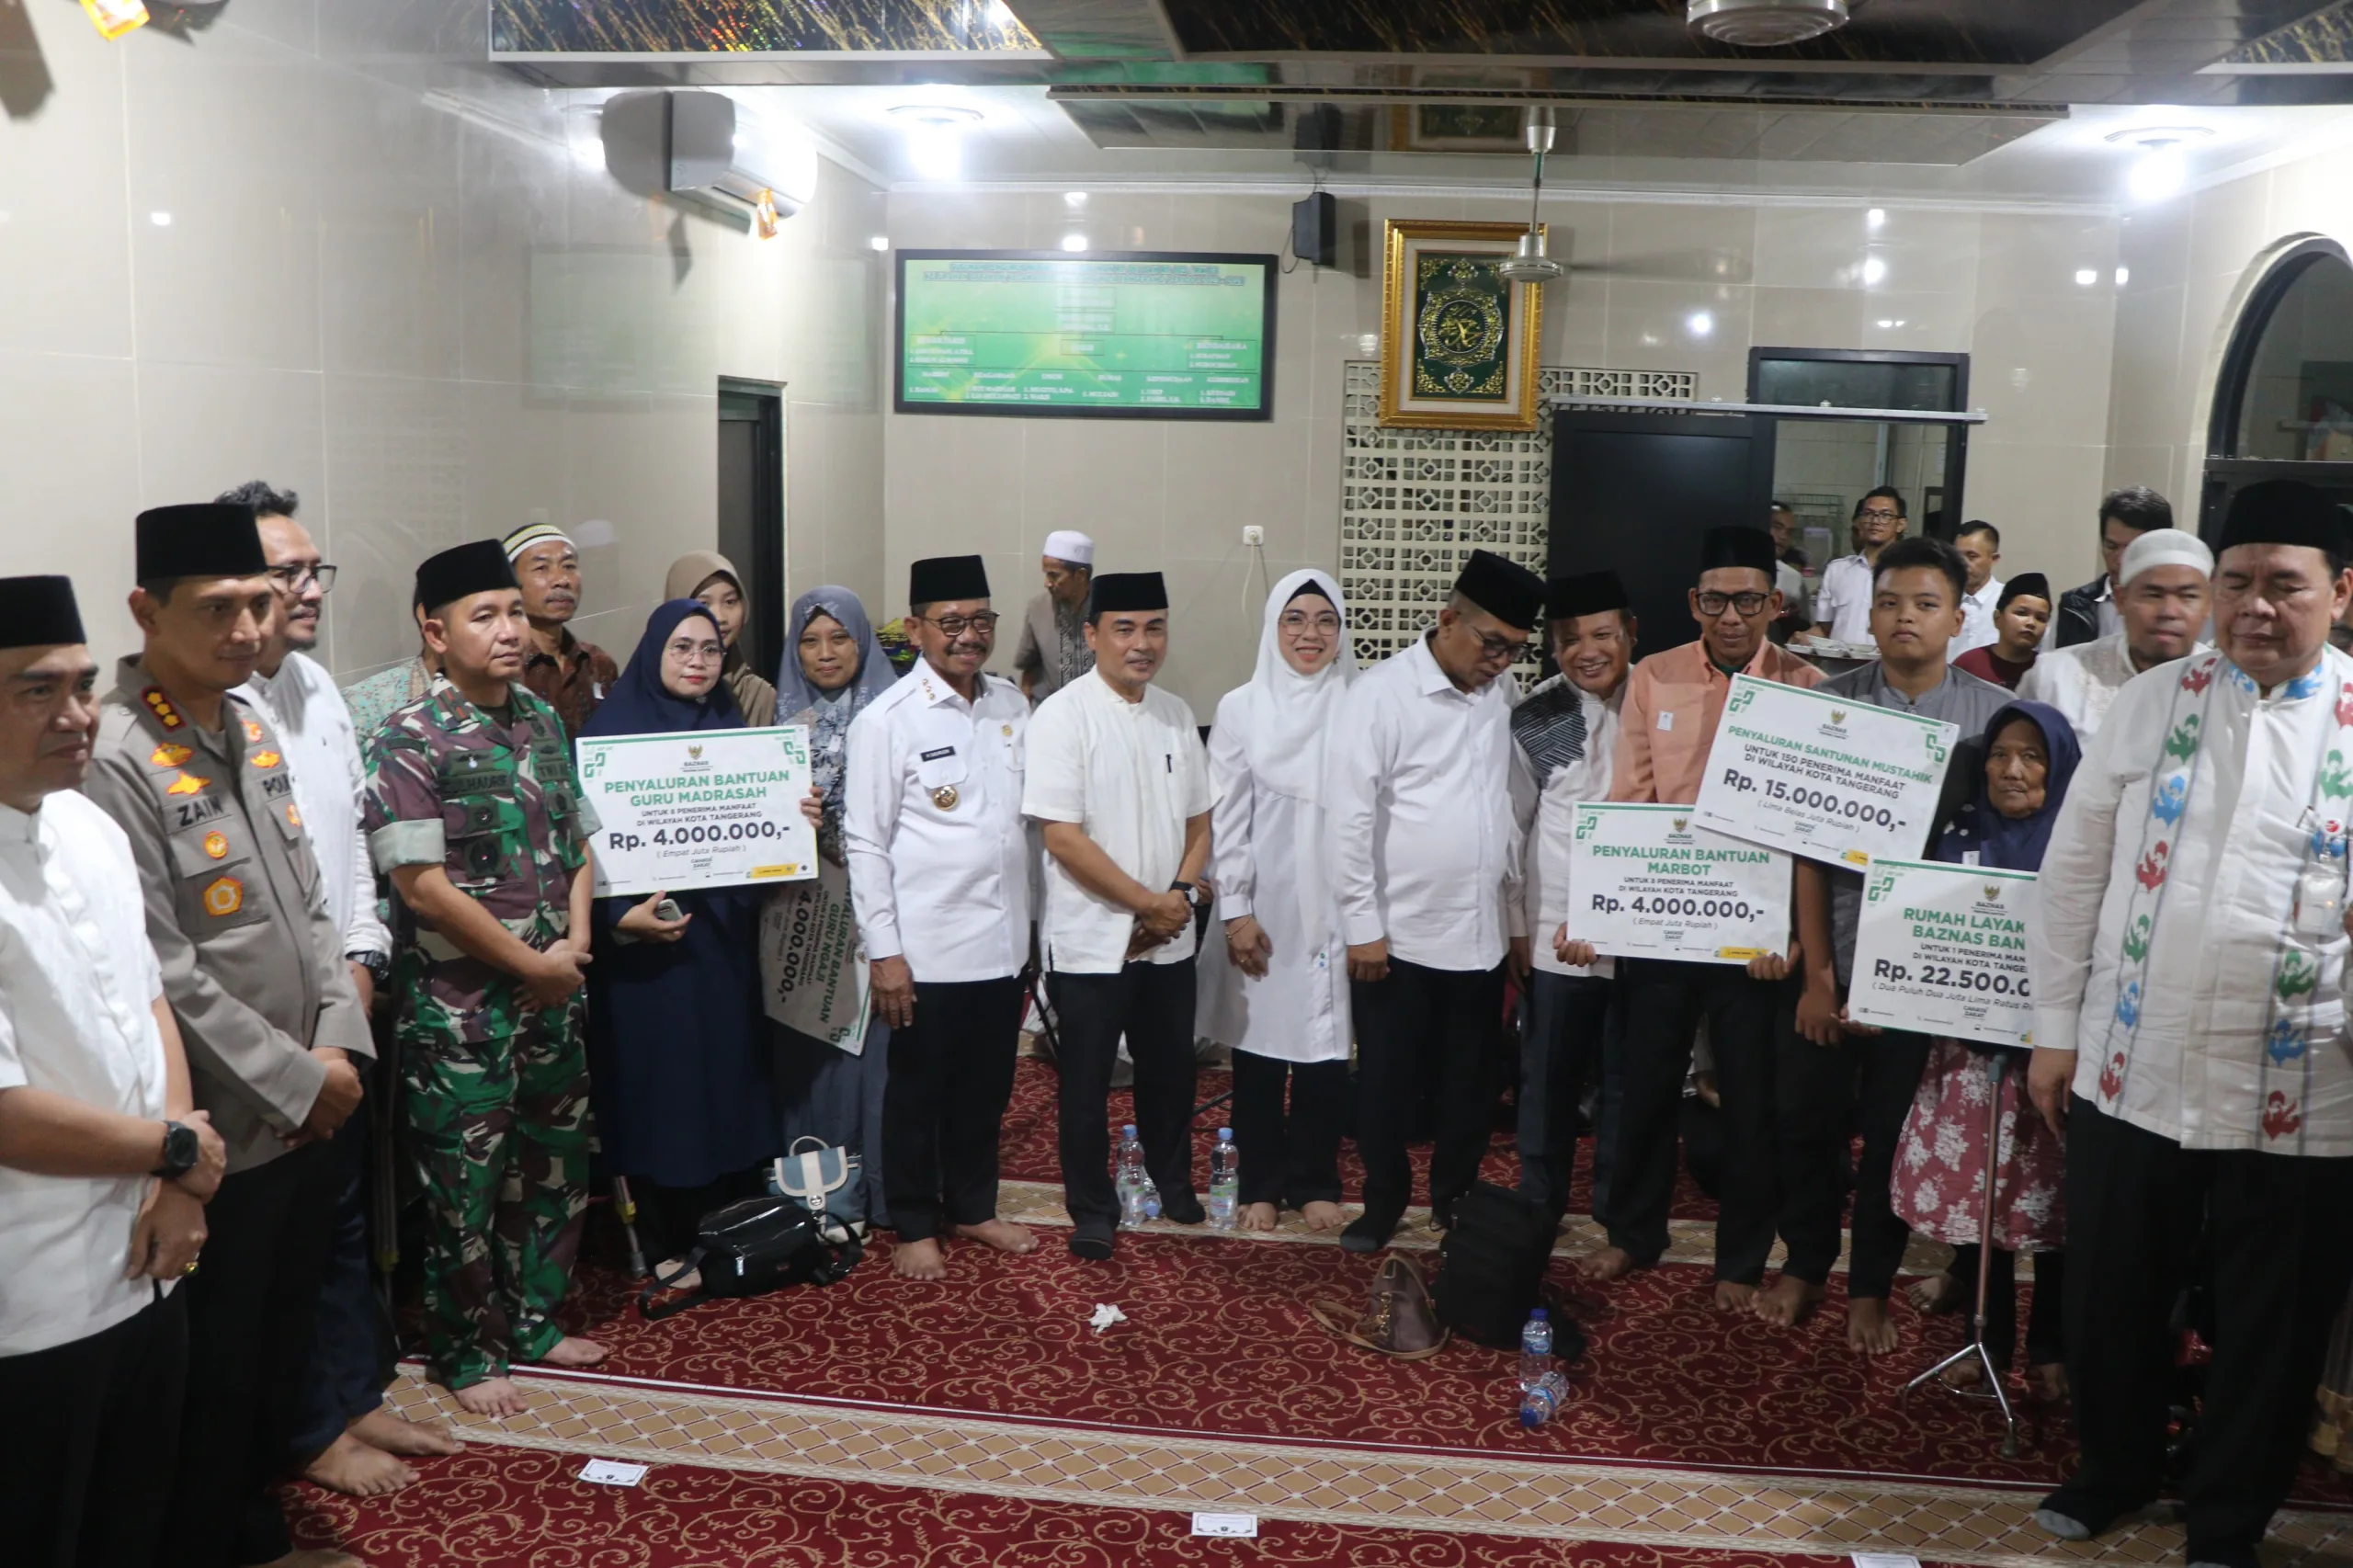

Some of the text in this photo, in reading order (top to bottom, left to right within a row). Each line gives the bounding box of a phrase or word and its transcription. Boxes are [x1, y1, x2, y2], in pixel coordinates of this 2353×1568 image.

[1728, 725, 1802, 751] PENYALURAN
[1804, 744, 1870, 767] SANTUNAN
[1871, 760, 1933, 784] MUSTAHIK
[1744, 753, 1899, 799] DI WILAYAH KOTA TANGERANG
[1745, 744, 1906, 790] UNTUK 150 PENERIMA MANFAAT
[604, 770, 789, 793] PENYALURAN BANTUAN
[631, 786, 767, 806] GURU MADRASAH
[1722, 767, 1906, 832] Rp. 15.000.000,-
[176, 795, 224, 827] ZAIN
[642, 809, 668, 817] UNTUK
[676, 805, 717, 813] PENERIMA
[719, 802, 756, 811] MANFAAT
[646, 817, 683, 825] WILAYAH
[684, 814, 707, 823] KOTA
[709, 811, 762, 820] TANGERANG
[609, 821, 790, 852] Rp. 4.000.000,-
[662, 848, 689, 858] Empat
[711, 845, 741, 853] Rupiah
[1592, 845, 1769, 863] PENYALURAN BANTUAN
[1647, 861, 1711, 875] MARBOT
[1656, 878, 1695, 886] PENERIMA
[1687, 888, 1737, 897] TANGERANG
[1591, 893, 1764, 923] Rp. 4.000.000,-
[1904, 907, 1966, 926] RUMAH
[1970, 915, 2025, 933] LAYAK
[1638, 917, 1664, 926] Empat
[1684, 920, 1712, 928] Rupiah
[777, 887, 812, 1003] 4.000.000,-
[815, 903, 839, 982] GURU NGAJI
[1913, 925, 1984, 945] BAZNAS
[1920, 944, 1949, 952] UNTUK
[1957, 948, 2003, 960] PENERIMA
[1924, 953, 1963, 964] WILAYAH
[1965, 959, 1990, 968] KOTA
[1994, 961, 2028, 973] TANGE
[1874, 958, 1912, 983] Rp.
[819, 960, 840, 1023] BANTUAN
[1878, 982, 1896, 992] Dua
[1898, 984, 1924, 995] Puluh
[1925, 988, 1944, 998] Dua
[1945, 993, 1966, 1002] Juta
[1967, 995, 1991, 1005] Lima
[1993, 998, 2020, 1009] Ratus
